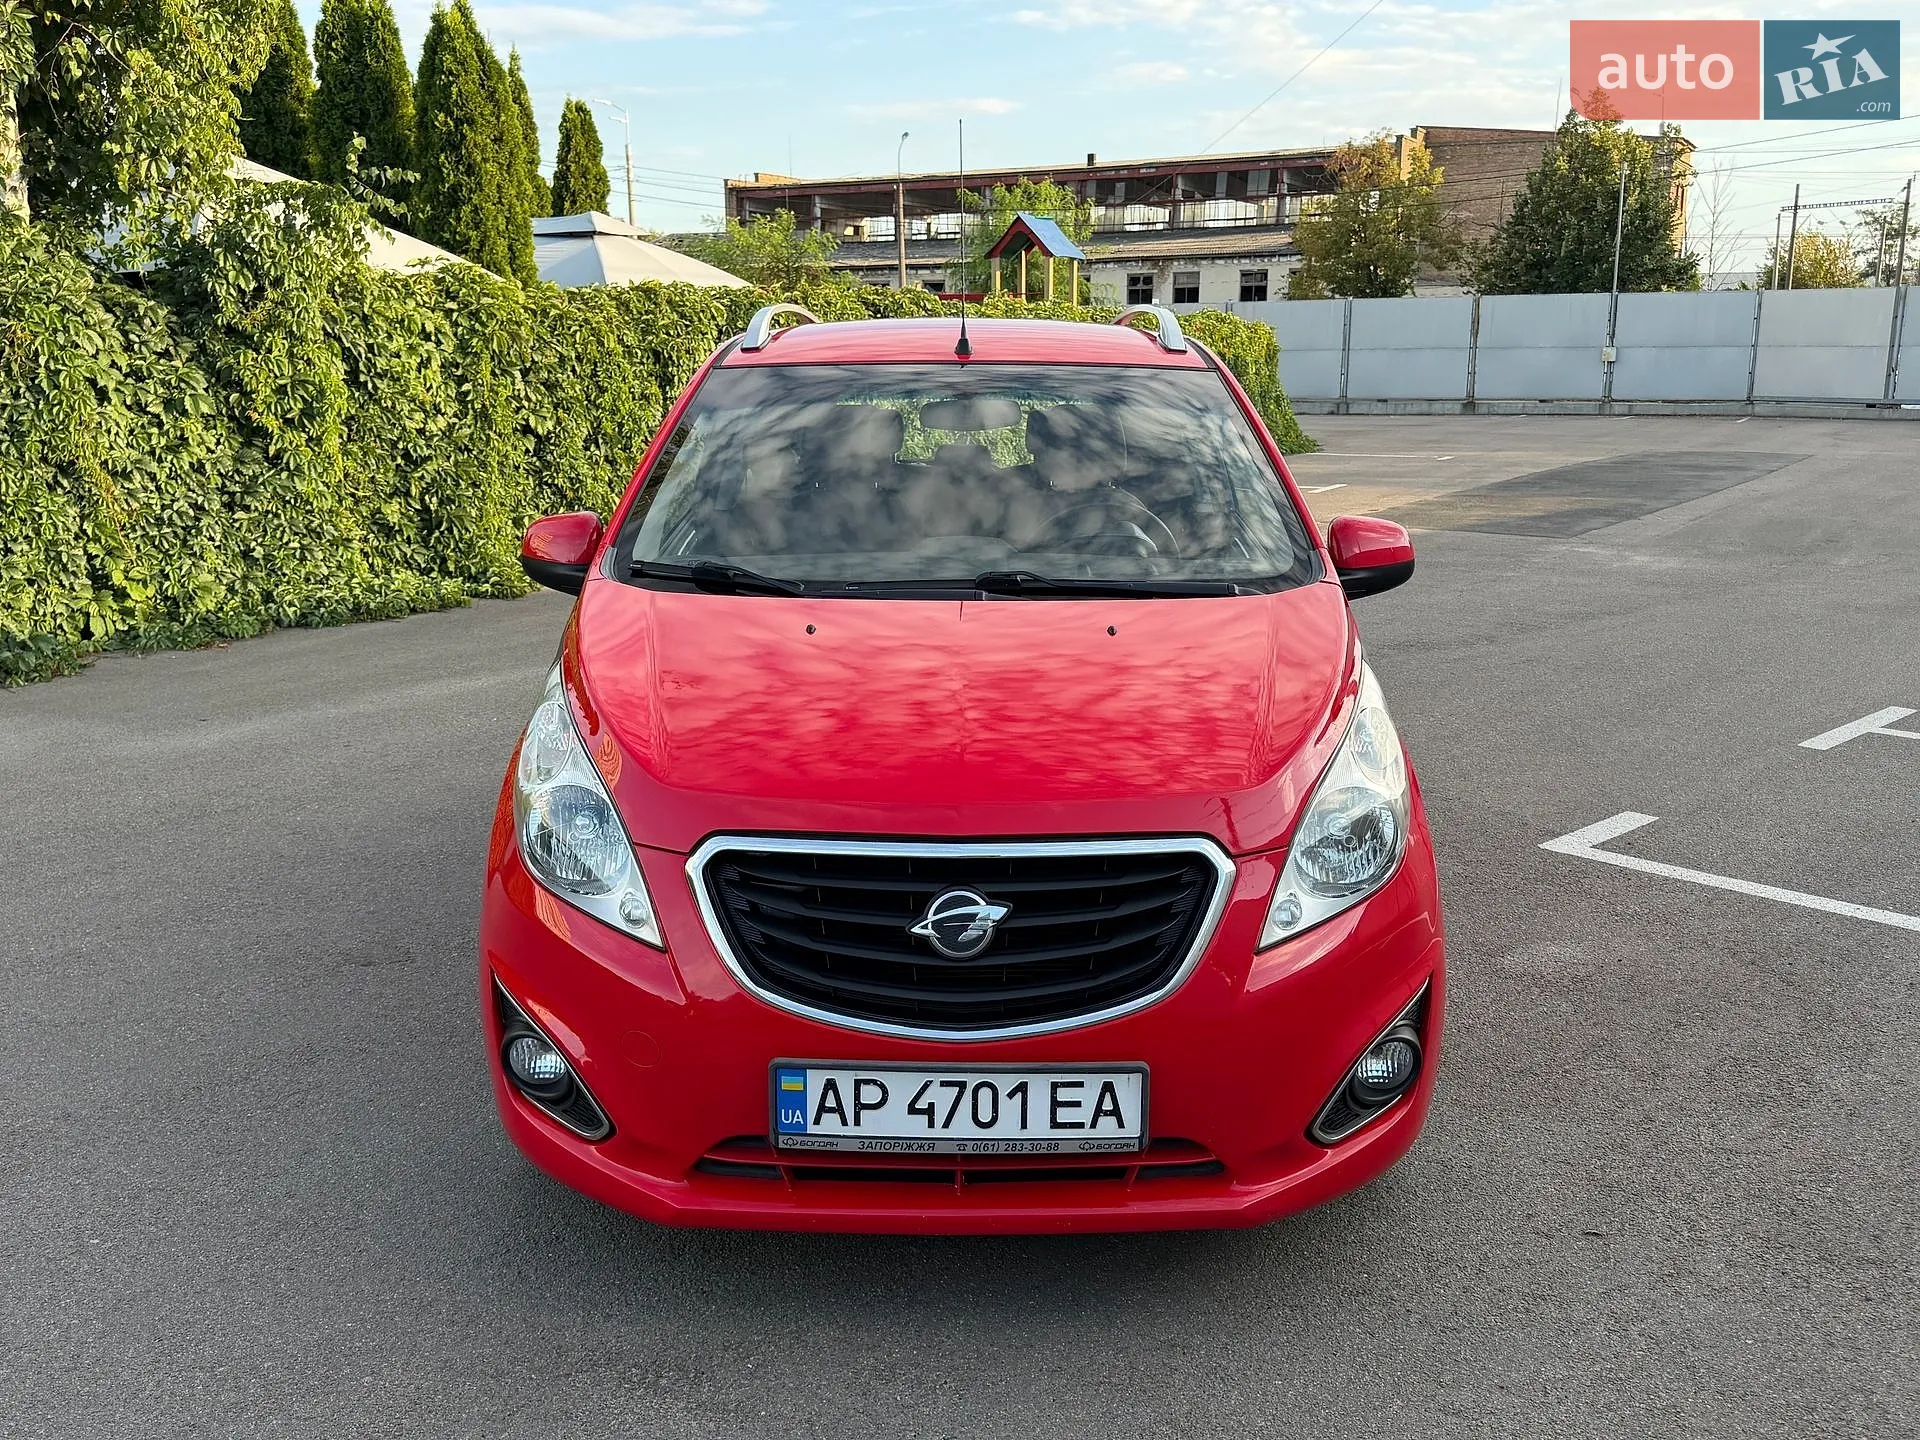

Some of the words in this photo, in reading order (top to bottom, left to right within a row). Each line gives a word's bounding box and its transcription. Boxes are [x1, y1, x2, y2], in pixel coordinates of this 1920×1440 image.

[812, 1077, 889, 1127] AP
[907, 1079, 1029, 1130] 4701
[1049, 1080, 1126, 1130] EA
[781, 1109, 804, 1125] UA
[858, 1139, 936, 1152] ЗАПОРІЖЖЯ
[971, 1141, 1000, 1153] 0(61)
[1004, 1141, 1060, 1153] 283-30-88
